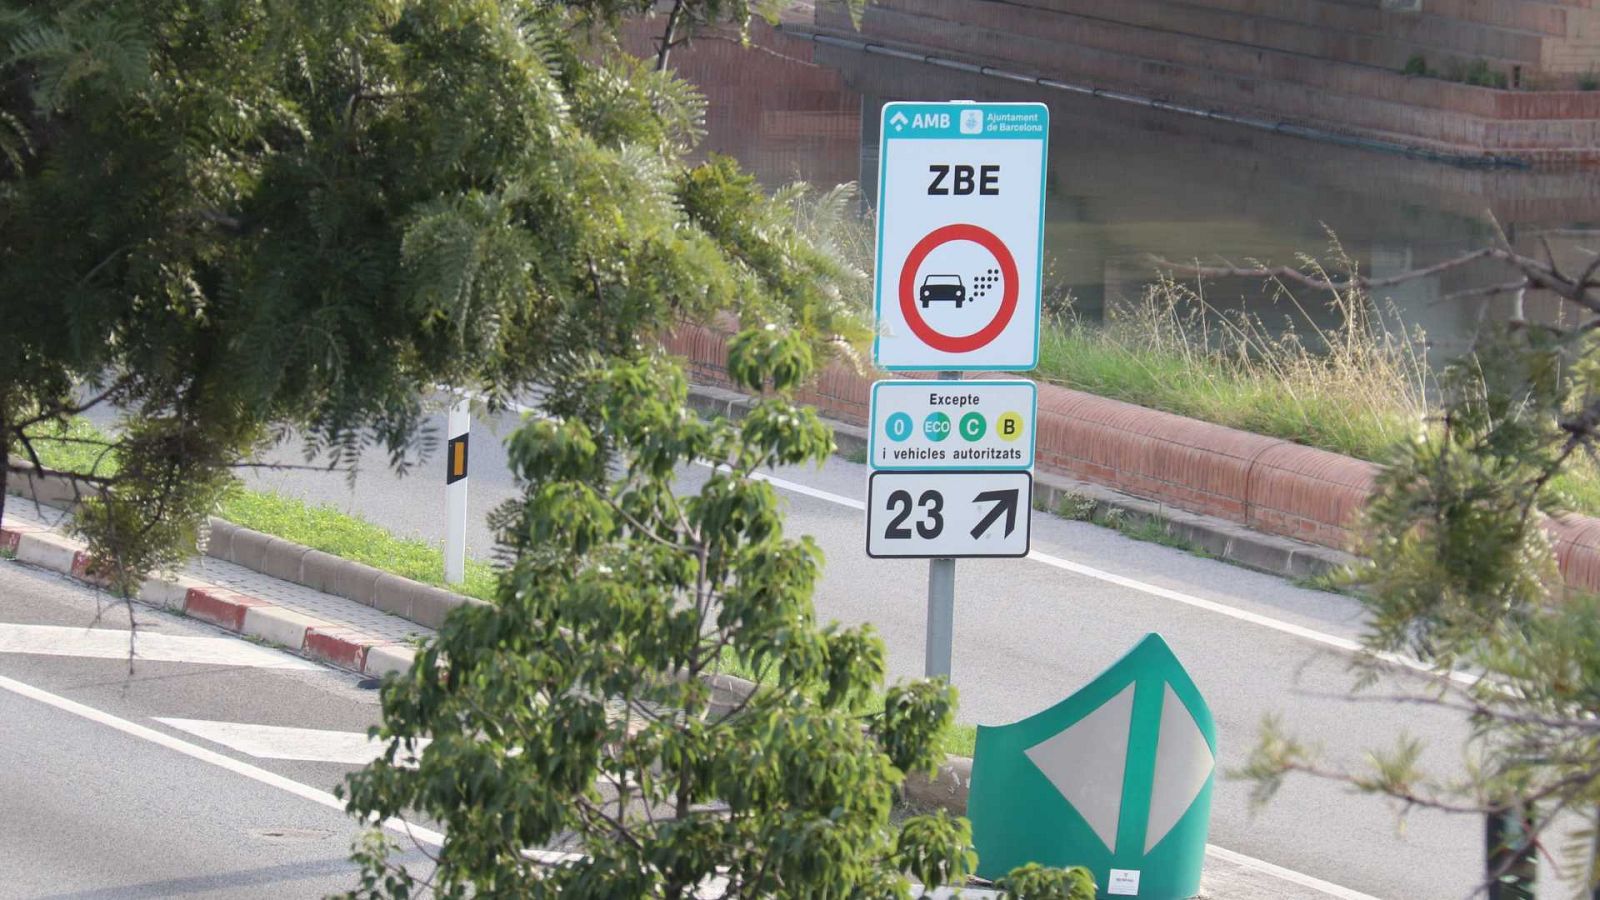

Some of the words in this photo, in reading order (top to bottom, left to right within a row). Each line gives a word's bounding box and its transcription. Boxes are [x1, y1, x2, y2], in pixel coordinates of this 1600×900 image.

[912, 113, 951, 129] AMB
[987, 113, 1039, 123] Ajuntament
[987, 123, 998, 131] de
[999, 123, 1043, 132] Barcelona
[928, 165, 1000, 196] ZBE
[929, 393, 980, 407] Excepte
[924, 420, 950, 433] ECO
[966, 420, 980, 435] C
[1004, 419, 1015, 434] B
[882, 447, 886, 459] i
[894, 447, 946, 460] vehicles
[953, 447, 1022, 460] autoritzats
[884, 489, 944, 540] 23
